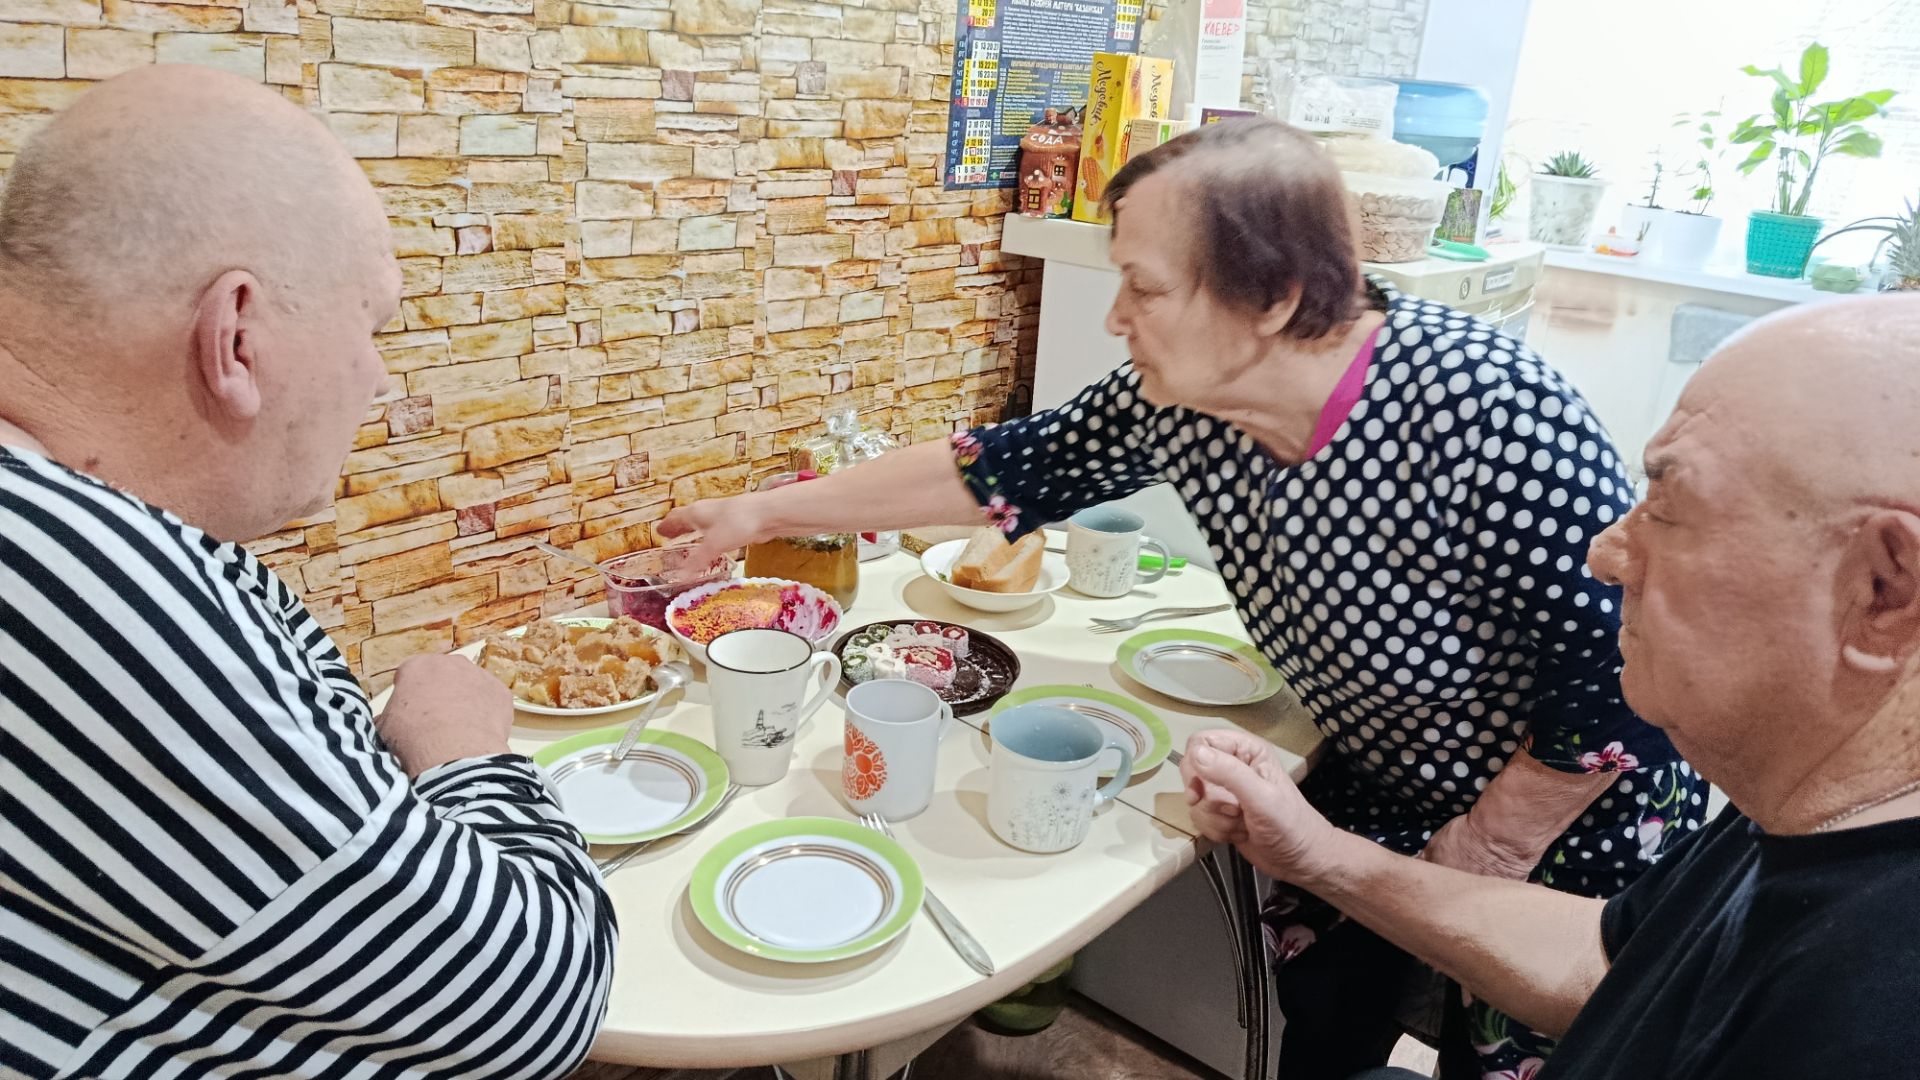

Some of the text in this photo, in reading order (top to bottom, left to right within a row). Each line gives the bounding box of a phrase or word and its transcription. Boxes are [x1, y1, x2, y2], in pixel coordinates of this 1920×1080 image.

[1204, 22, 1240, 36] КЛЕВЕР
[1090, 61, 1111, 126] Медовик
[1030, 133, 1063, 145] СОДА
